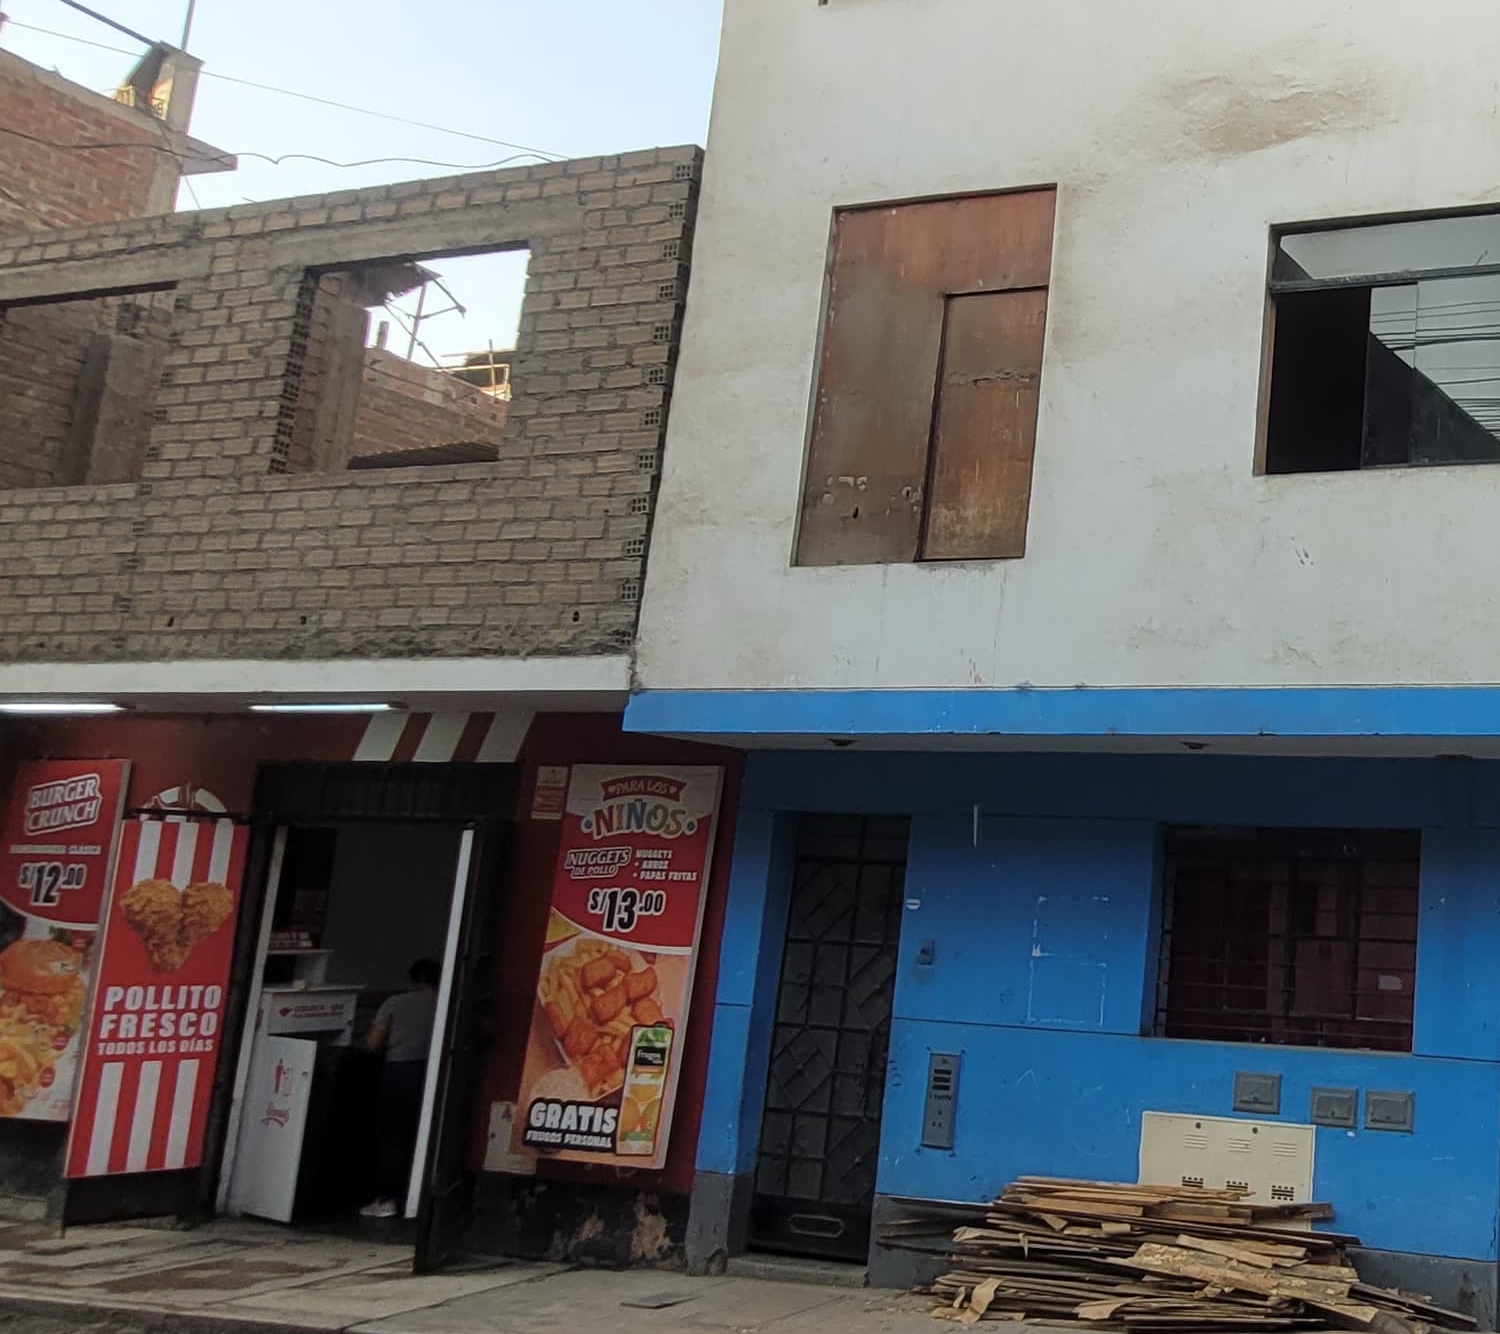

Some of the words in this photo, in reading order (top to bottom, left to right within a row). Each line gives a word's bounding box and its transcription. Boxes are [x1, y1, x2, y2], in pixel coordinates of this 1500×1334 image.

[30, 778, 98, 808] BURGER
[615, 779, 645, 795] PARA
[647, 780, 669, 794] LOS
[27, 800, 97, 831] CRUNCH
[593, 798, 687, 839] NIÑOS
[567, 849, 630, 867] NUGGETS
[636, 849, 672, 859] NUGGETS
[587, 865, 616, 875] POLLO
[639, 871, 666, 881] PAPAS
[668, 871, 697, 882] FRITAS
[19, 862, 86, 906] S/12.00
[588, 887, 666, 932] S/13.00
[103, 985, 222, 1011] POLLITO
[99, 1011, 218, 1039] FRESCO
[97, 1041, 145, 1056] TODOS
[148, 1040, 177, 1054] LOS
[179, 1037, 214, 1052] DÍAS
[529, 1102, 618, 1135] GRATIS
[564, 1132, 613, 1148] PERSONAL
